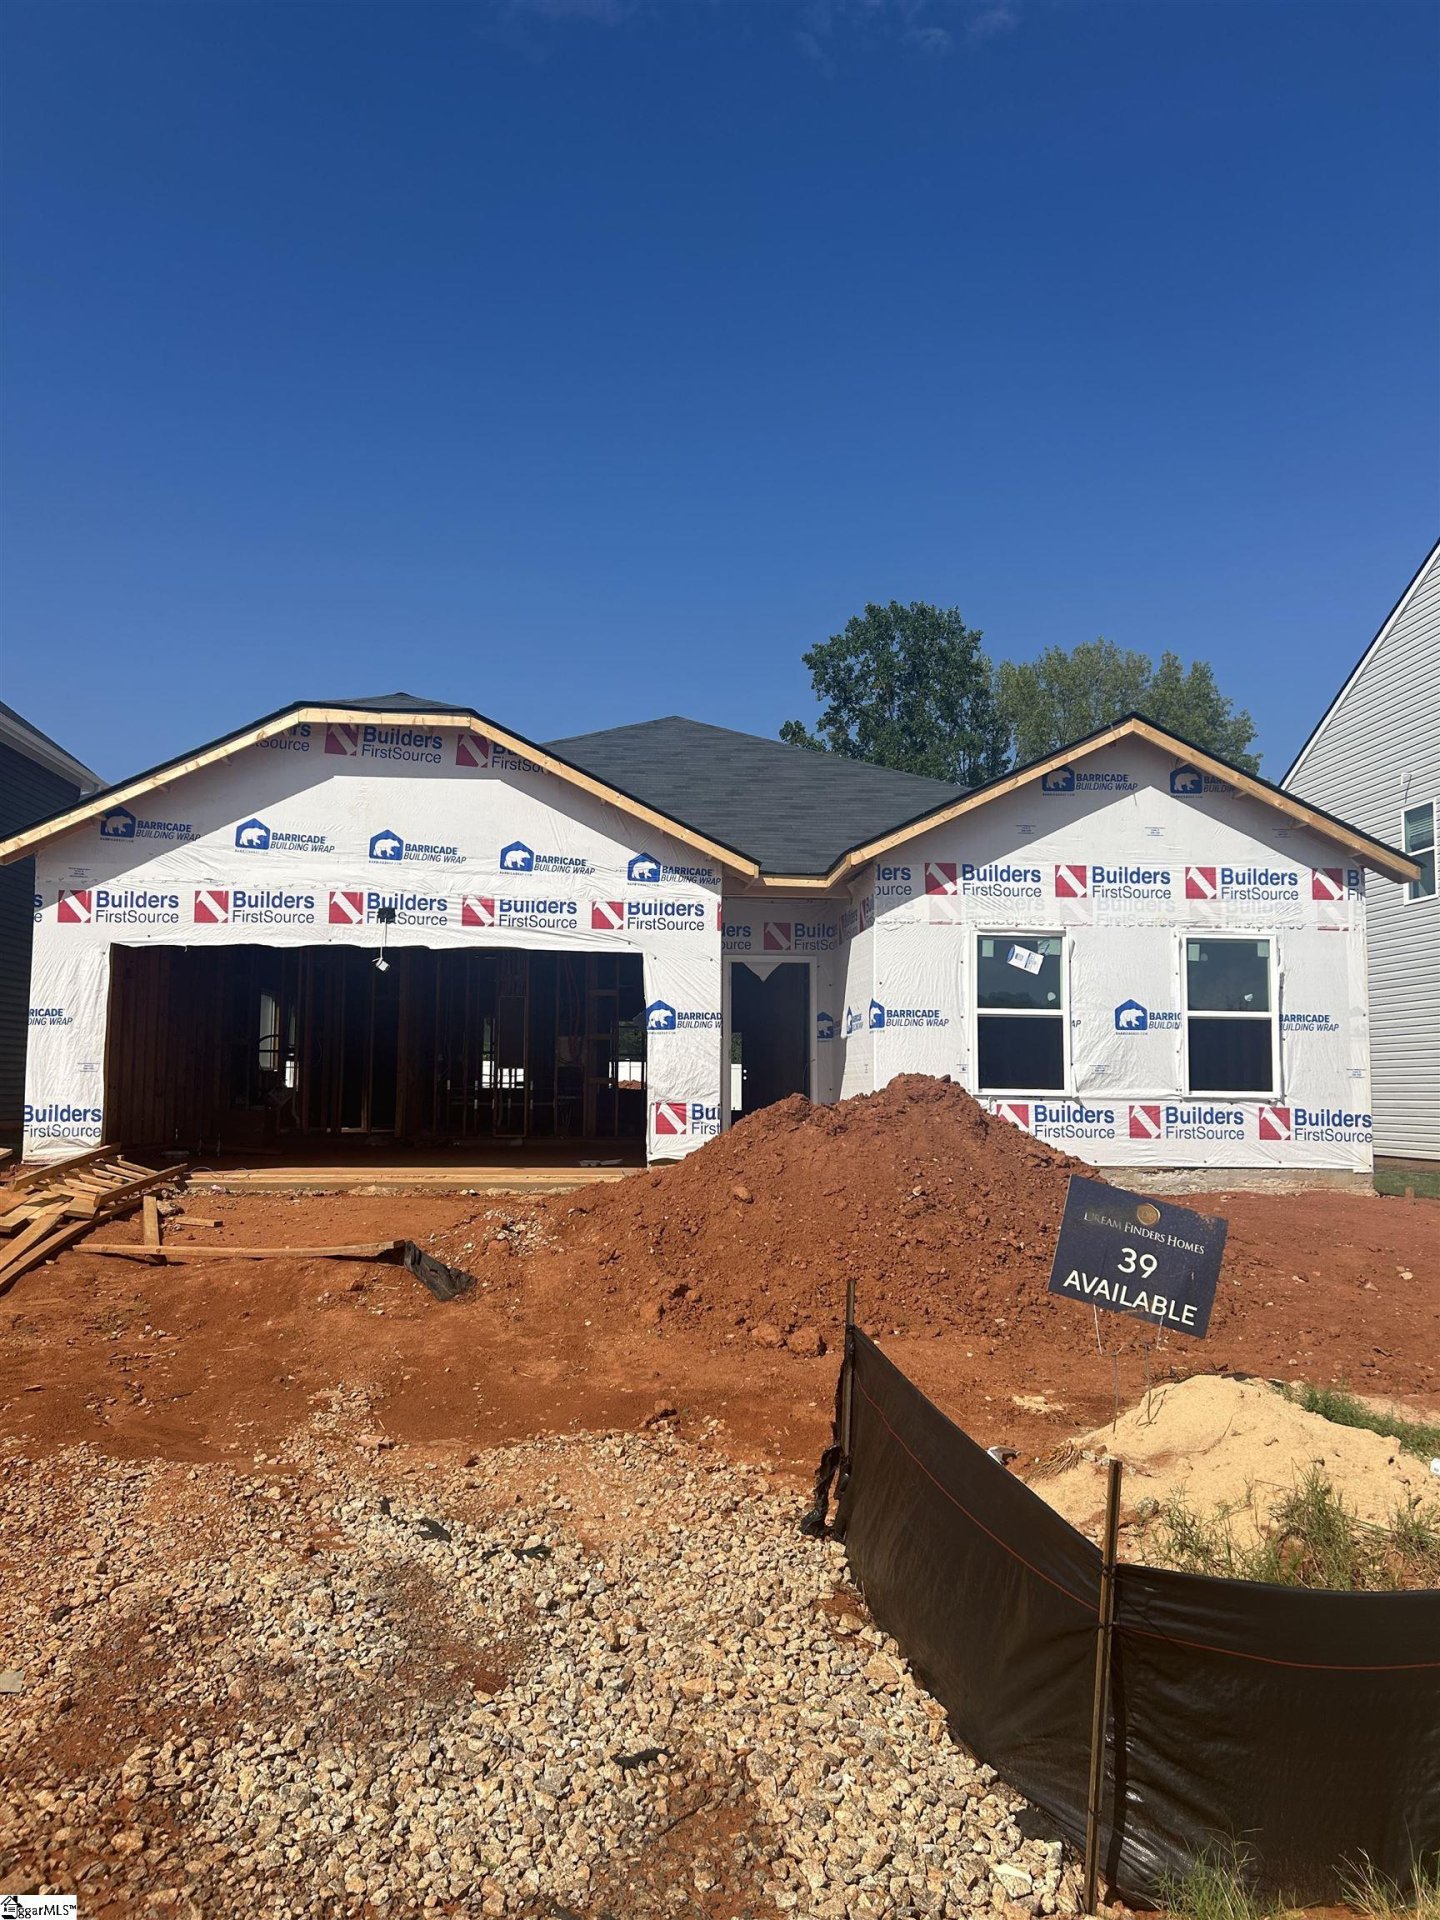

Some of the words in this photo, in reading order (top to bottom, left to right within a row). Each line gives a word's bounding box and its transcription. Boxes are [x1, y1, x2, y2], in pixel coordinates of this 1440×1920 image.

[362, 725, 443, 750] Builders
[360, 744, 442, 764] FirstSource
[1076, 773, 1130, 783] BARRICADE
[1075, 781, 1112, 791] BUILDING
[1114, 782, 1138, 792] WRAP
[137, 820, 193, 833] BARRICADE
[135, 828, 176, 841] BUILDING
[176, 832, 201, 842] WRAP
[271, 832, 327, 844] BARRICADE
[270, 840, 310, 852] BUILDING
[311, 843, 336, 854] WRAP
[404, 843, 458, 856] BARRICADE
[403, 851, 442, 863] BUILDING
[443, 855, 467, 865] WRAP
[535, 854, 588, 867] BARRICADE
[534, 862, 571, 875] BUILDING
[572, 866, 596, 876] WRAP
[661, 865, 713, 877] BARRICADE
[962, 863, 1042, 882] Builders
[1092, 866, 1171, 884] Builders
[1221, 867, 1299, 886] Builders
[660, 873, 698, 885] BUILDING
[699, 876, 722, 886] WRAP
[962, 883, 1042, 898] FirstSource
[1092, 885, 1172, 900] FirstSource
[1221, 887, 1299, 901] FirstSource
[96, 890, 180, 909] Builders
[232, 890, 315, 909] Builders
[366, 892, 448, 911] Builders
[499, 900, 578, 915] Builders
[627, 901, 705, 917] Builders
[95, 909, 180, 924] FirstSource
[232, 910, 315, 924] FirstSource
[499, 914, 578, 929] FirstSource
[627, 916, 705, 931] FirstSource
[886, 1009, 941, 1018] BARRICADE
[1279, 1014, 1331, 1023] BARRICADE
[48, 1017, 73, 1026] WRAP
[676, 1020, 713, 1029] BUILDING
[885, 1018, 924, 1027] BUILDING
[925, 1019, 950, 1027] WRAP
[1316, 1023, 1339, 1032] WRAP
[24, 1104, 102, 1123] Builders
[1034, 1105, 1115, 1124] Builders
[1165, 1106, 1245, 1125] Builders
[1294, 1107, 1373, 1128] Builders
[1034, 1124, 1116, 1139] FirstSource
[1165, 1126, 1245, 1141] FirstSource
[1294, 1126, 1373, 1143] FirstSource
[1117, 1247, 1158, 1279] 39
[1063, 1269, 1198, 1326] AVAILABLE
